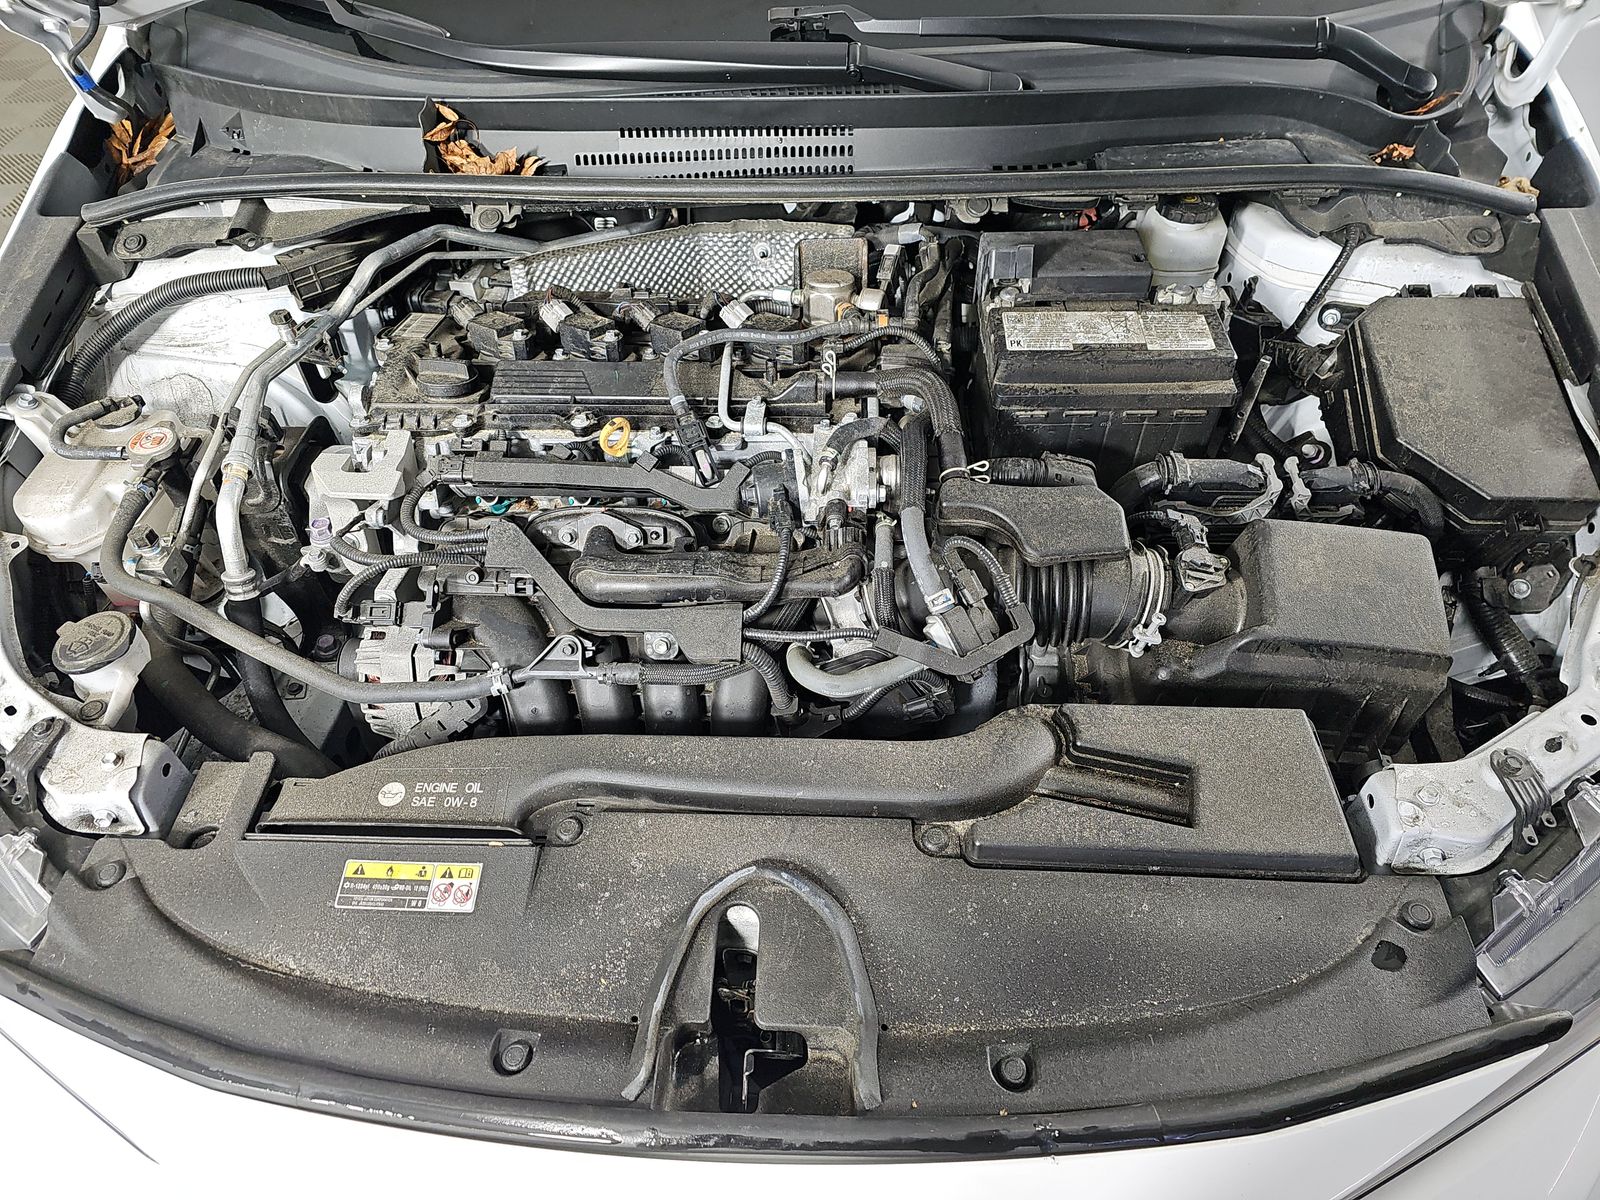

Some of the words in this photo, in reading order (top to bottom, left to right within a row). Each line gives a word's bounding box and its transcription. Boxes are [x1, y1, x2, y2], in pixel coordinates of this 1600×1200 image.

[1010, 339, 1024, 349] PK
[415, 782, 458, 793] ENGINE
[465, 782, 484, 793] OIL
[411, 796, 436, 807] SAE
[444, 796, 478, 808] 0W-8
